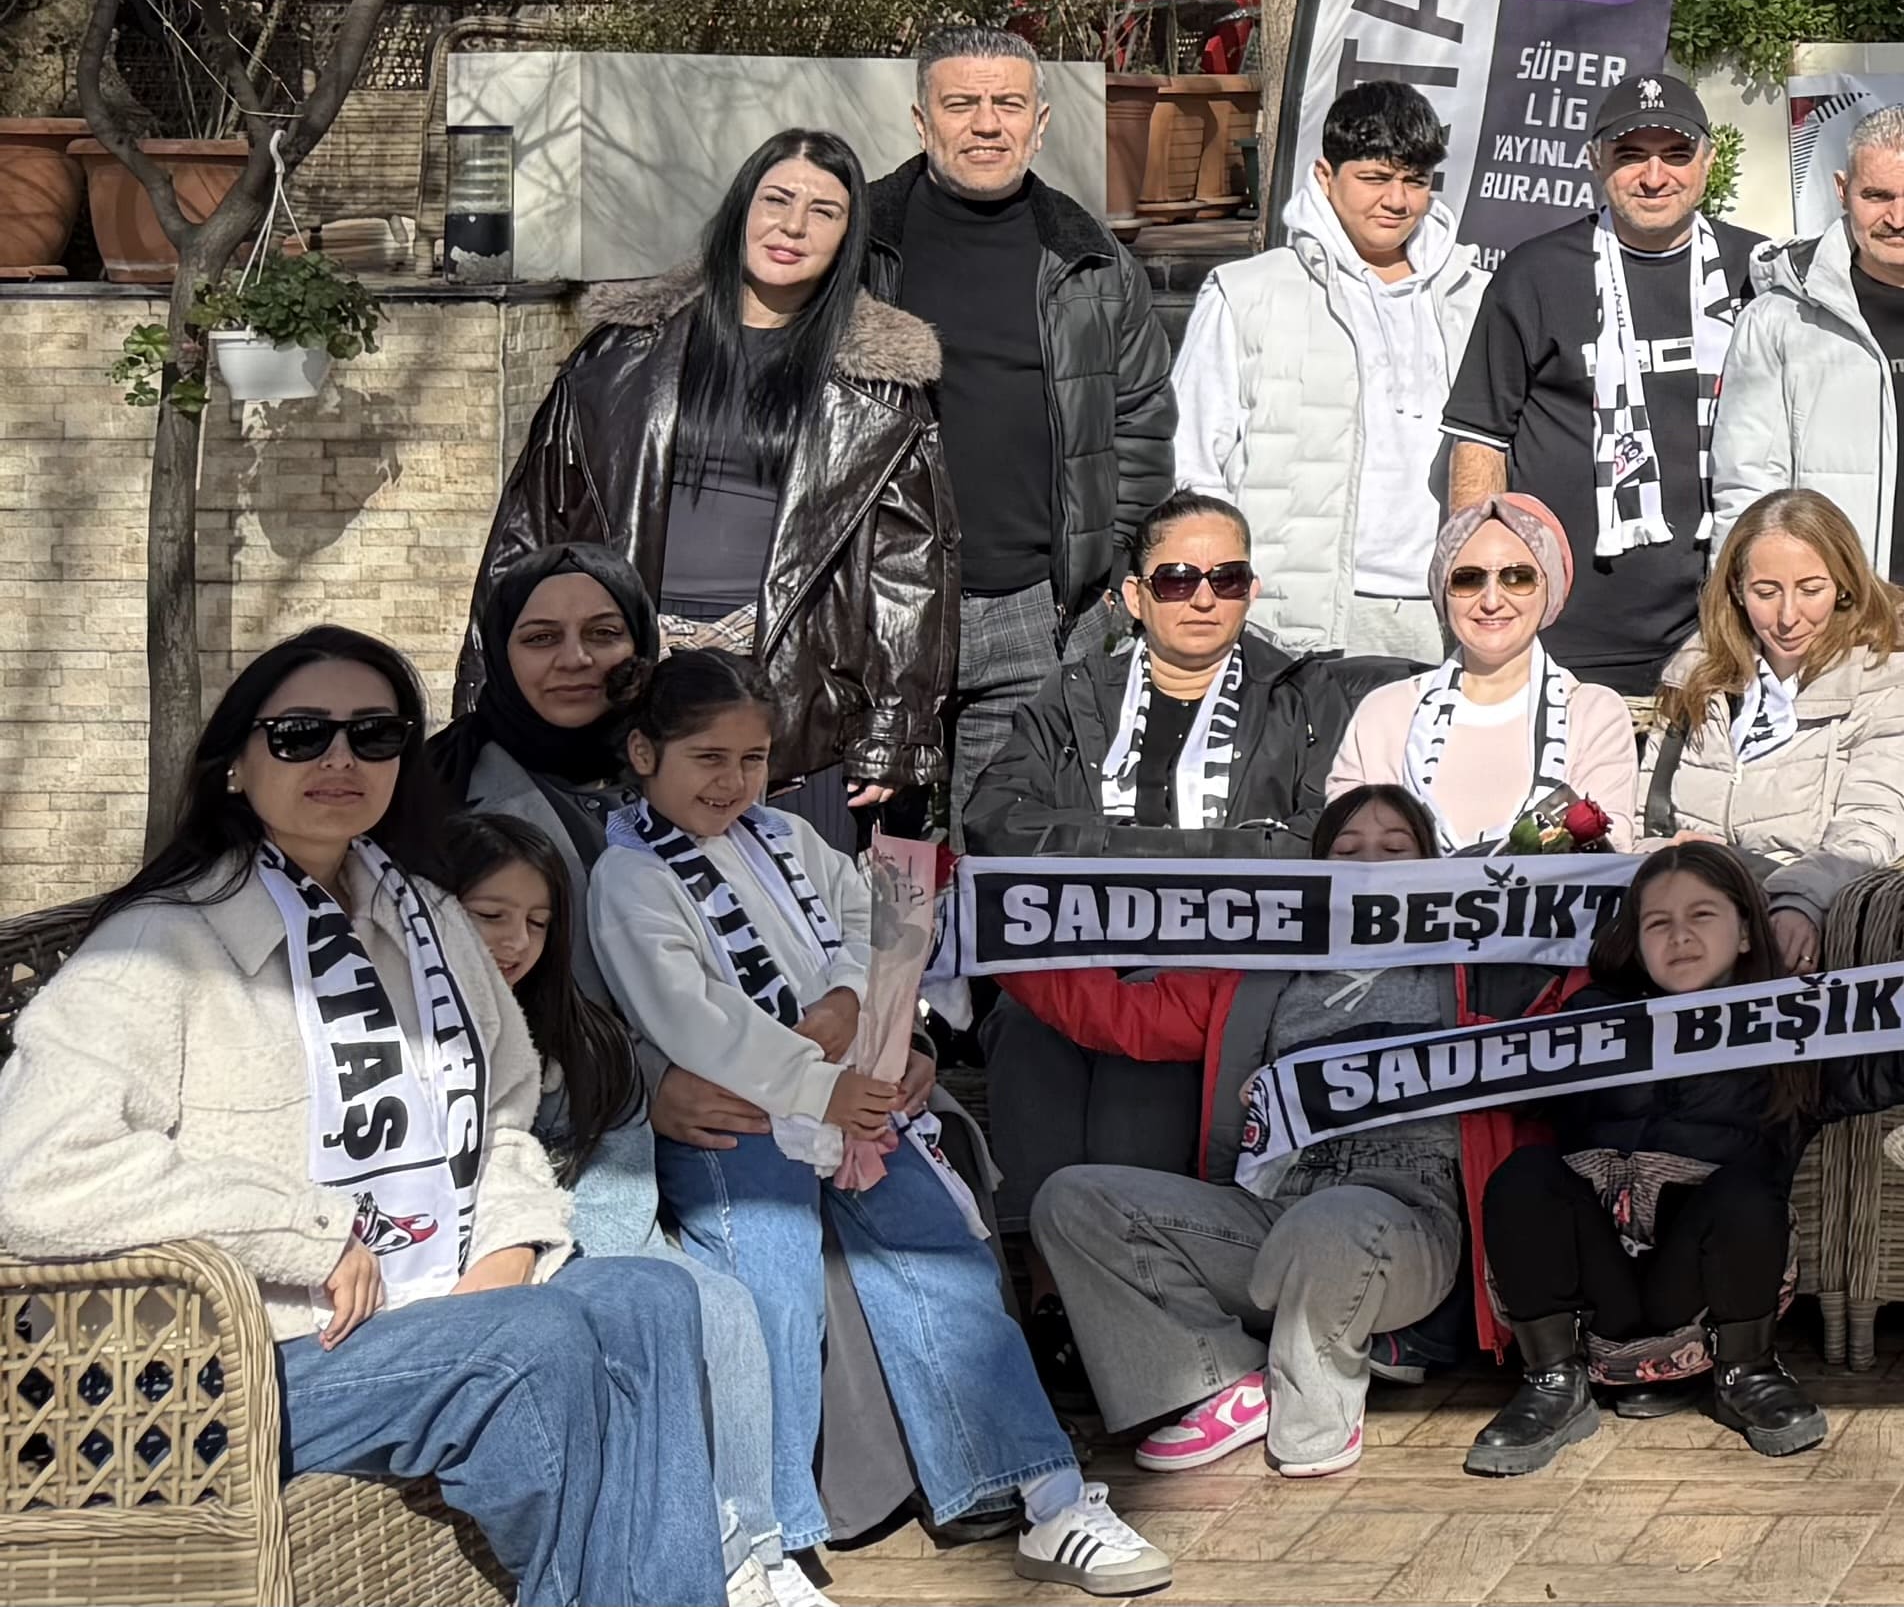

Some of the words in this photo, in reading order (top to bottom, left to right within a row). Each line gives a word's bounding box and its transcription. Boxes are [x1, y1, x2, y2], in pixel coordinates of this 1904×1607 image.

[1516, 40, 1627, 87] SÜPER
[1524, 87, 1589, 131] LİG
[1493, 133, 1592, 171] YAYINLA
[1480, 171, 1595, 210] BURADA
[1002, 883, 1304, 946] SADECE
[1350, 875, 1628, 951] BEŞİKT
[1321, 1018, 1628, 1113] SADECE
